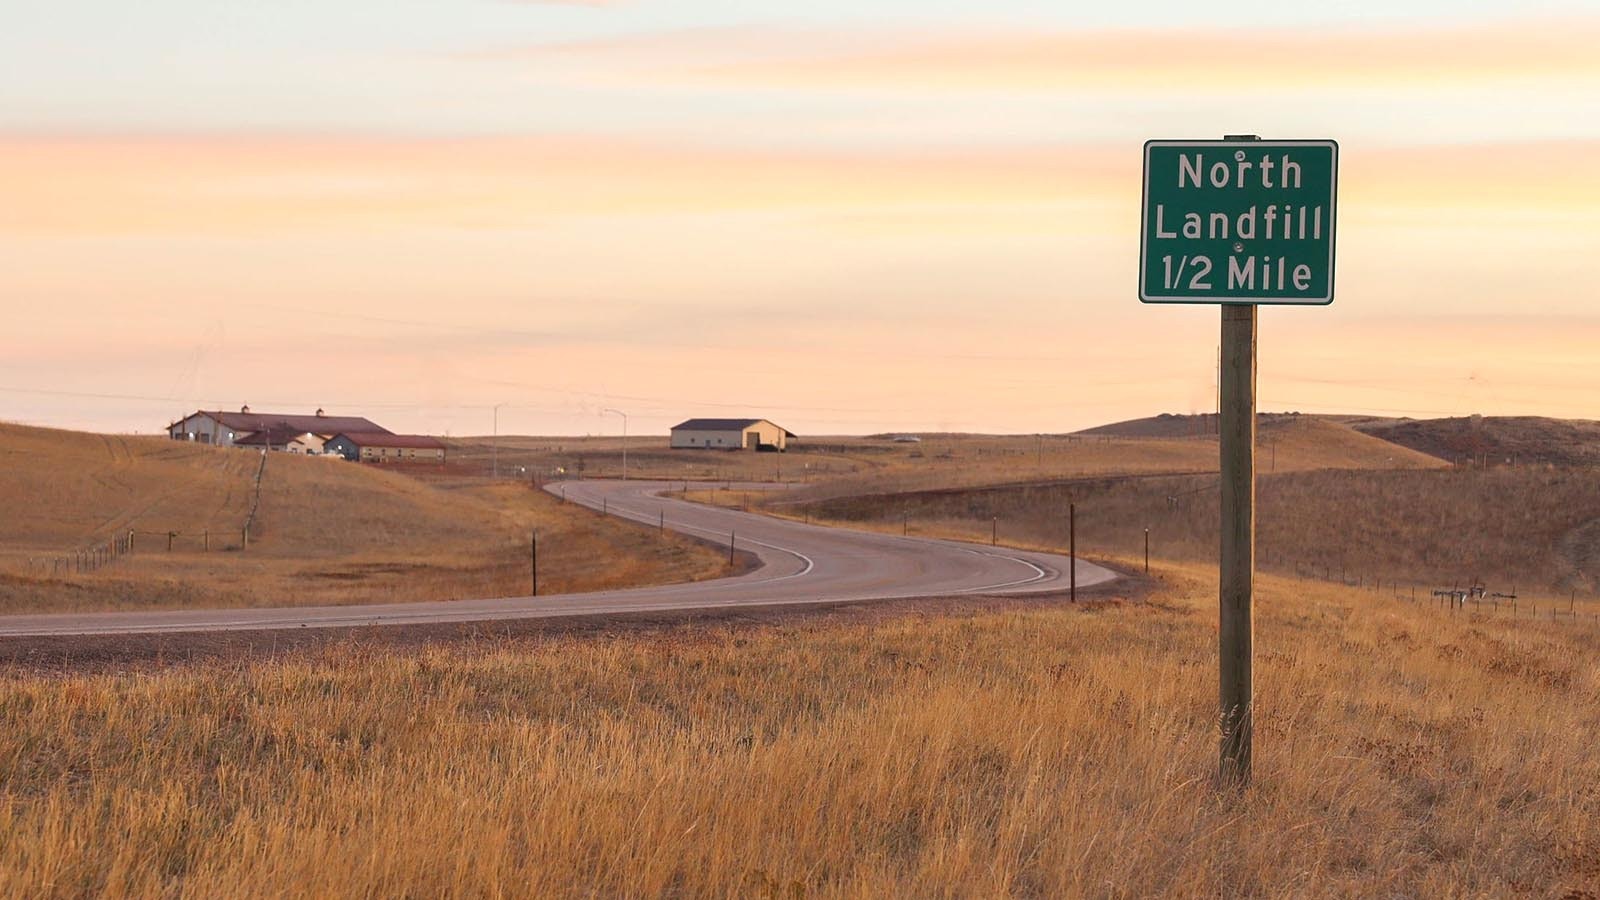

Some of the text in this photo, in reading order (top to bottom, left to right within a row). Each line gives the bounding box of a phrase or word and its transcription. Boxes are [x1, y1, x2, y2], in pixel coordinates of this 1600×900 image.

[1178, 154, 1301, 188] North
[1156, 204, 1321, 240] Landfill
[1162, 255, 1312, 291] 1/2 Mile
